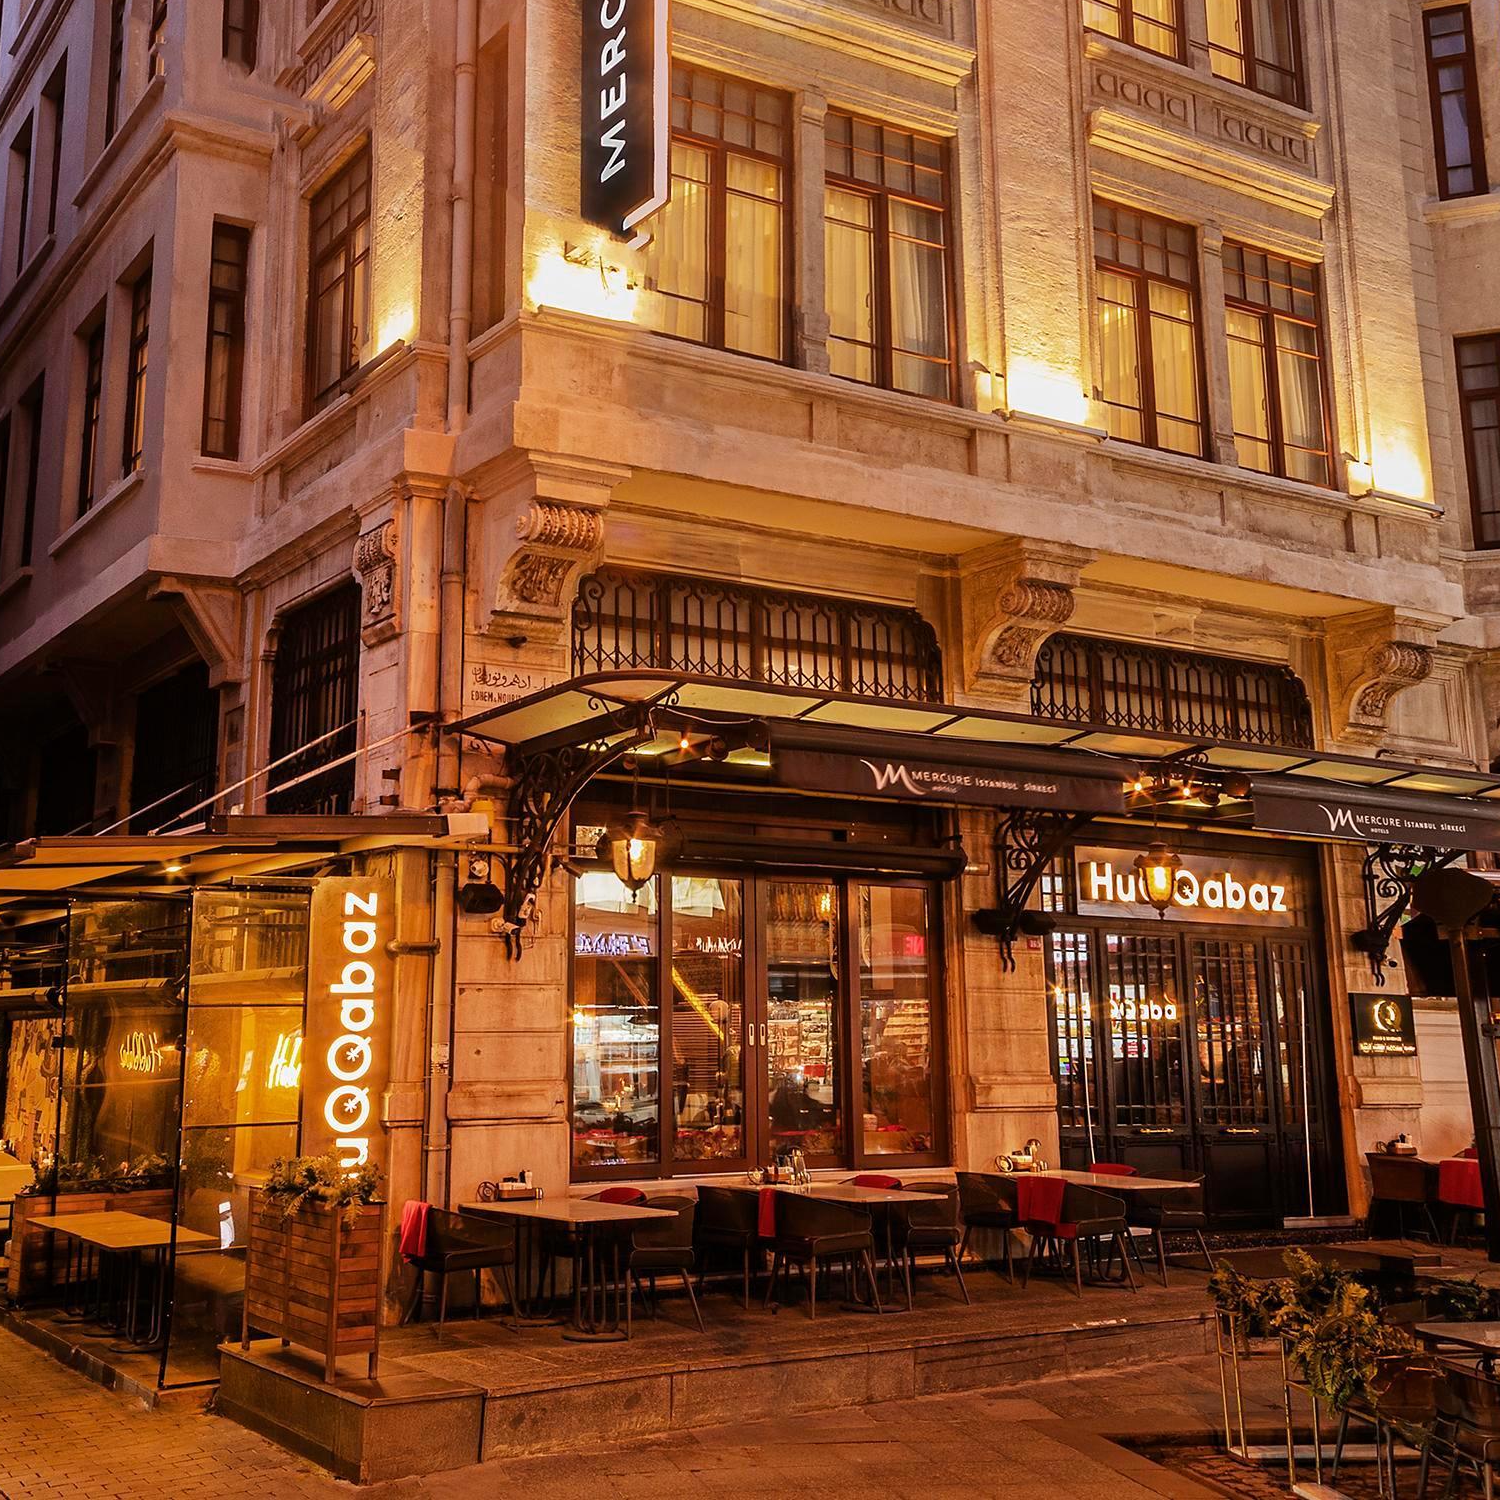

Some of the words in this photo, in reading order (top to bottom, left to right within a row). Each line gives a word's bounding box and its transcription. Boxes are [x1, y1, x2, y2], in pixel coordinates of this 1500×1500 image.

[911, 771, 971, 786] MERCURE
[1356, 815, 1401, 827] MERCURE
[1090, 862, 1287, 912] HuQabaz
[324, 892, 378, 1182] uQQabaz
